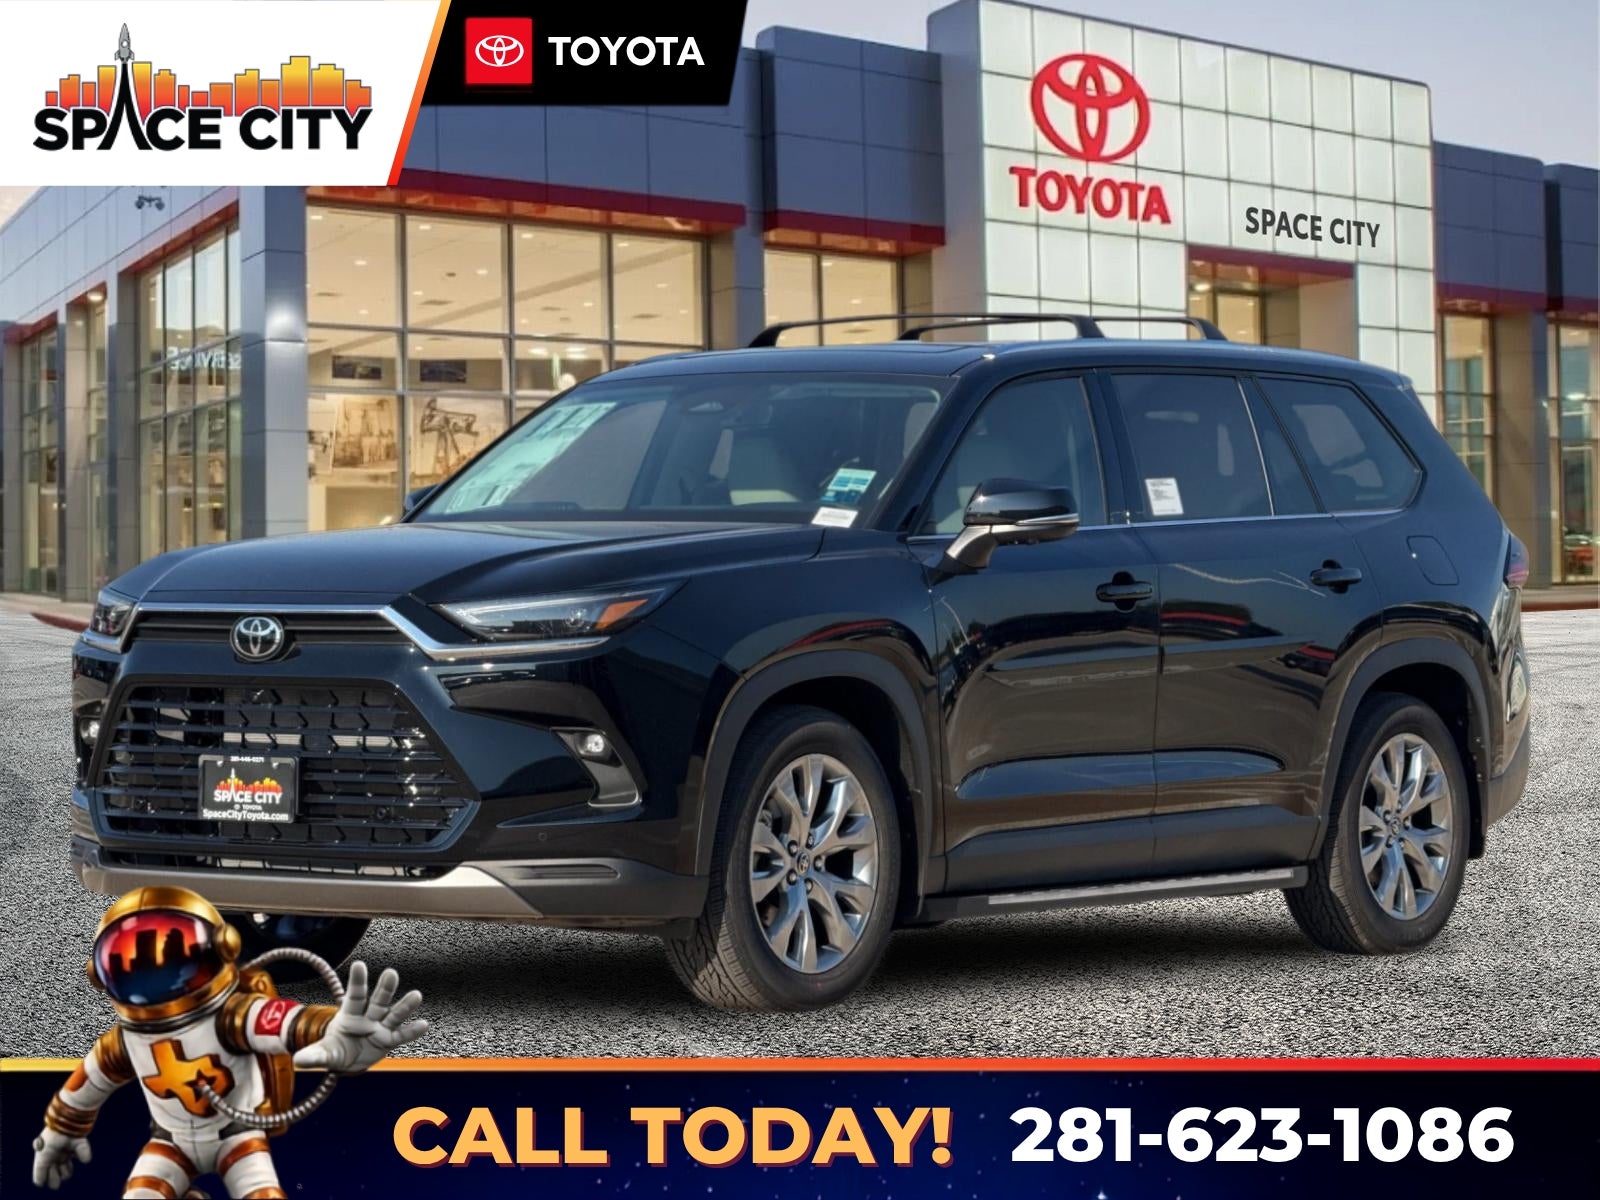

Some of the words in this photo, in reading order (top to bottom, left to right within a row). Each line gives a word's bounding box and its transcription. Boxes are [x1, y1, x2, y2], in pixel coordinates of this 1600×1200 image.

[1009, 166, 1171, 225] TOYOTA
[1245, 206, 1323, 242] SPACE
[1329, 217, 1381, 248] CITY
[214, 788, 252, 803] SPACE
[254, 791, 282, 804] CITY
[203, 809, 289, 821] SpaceCityToyota.com
